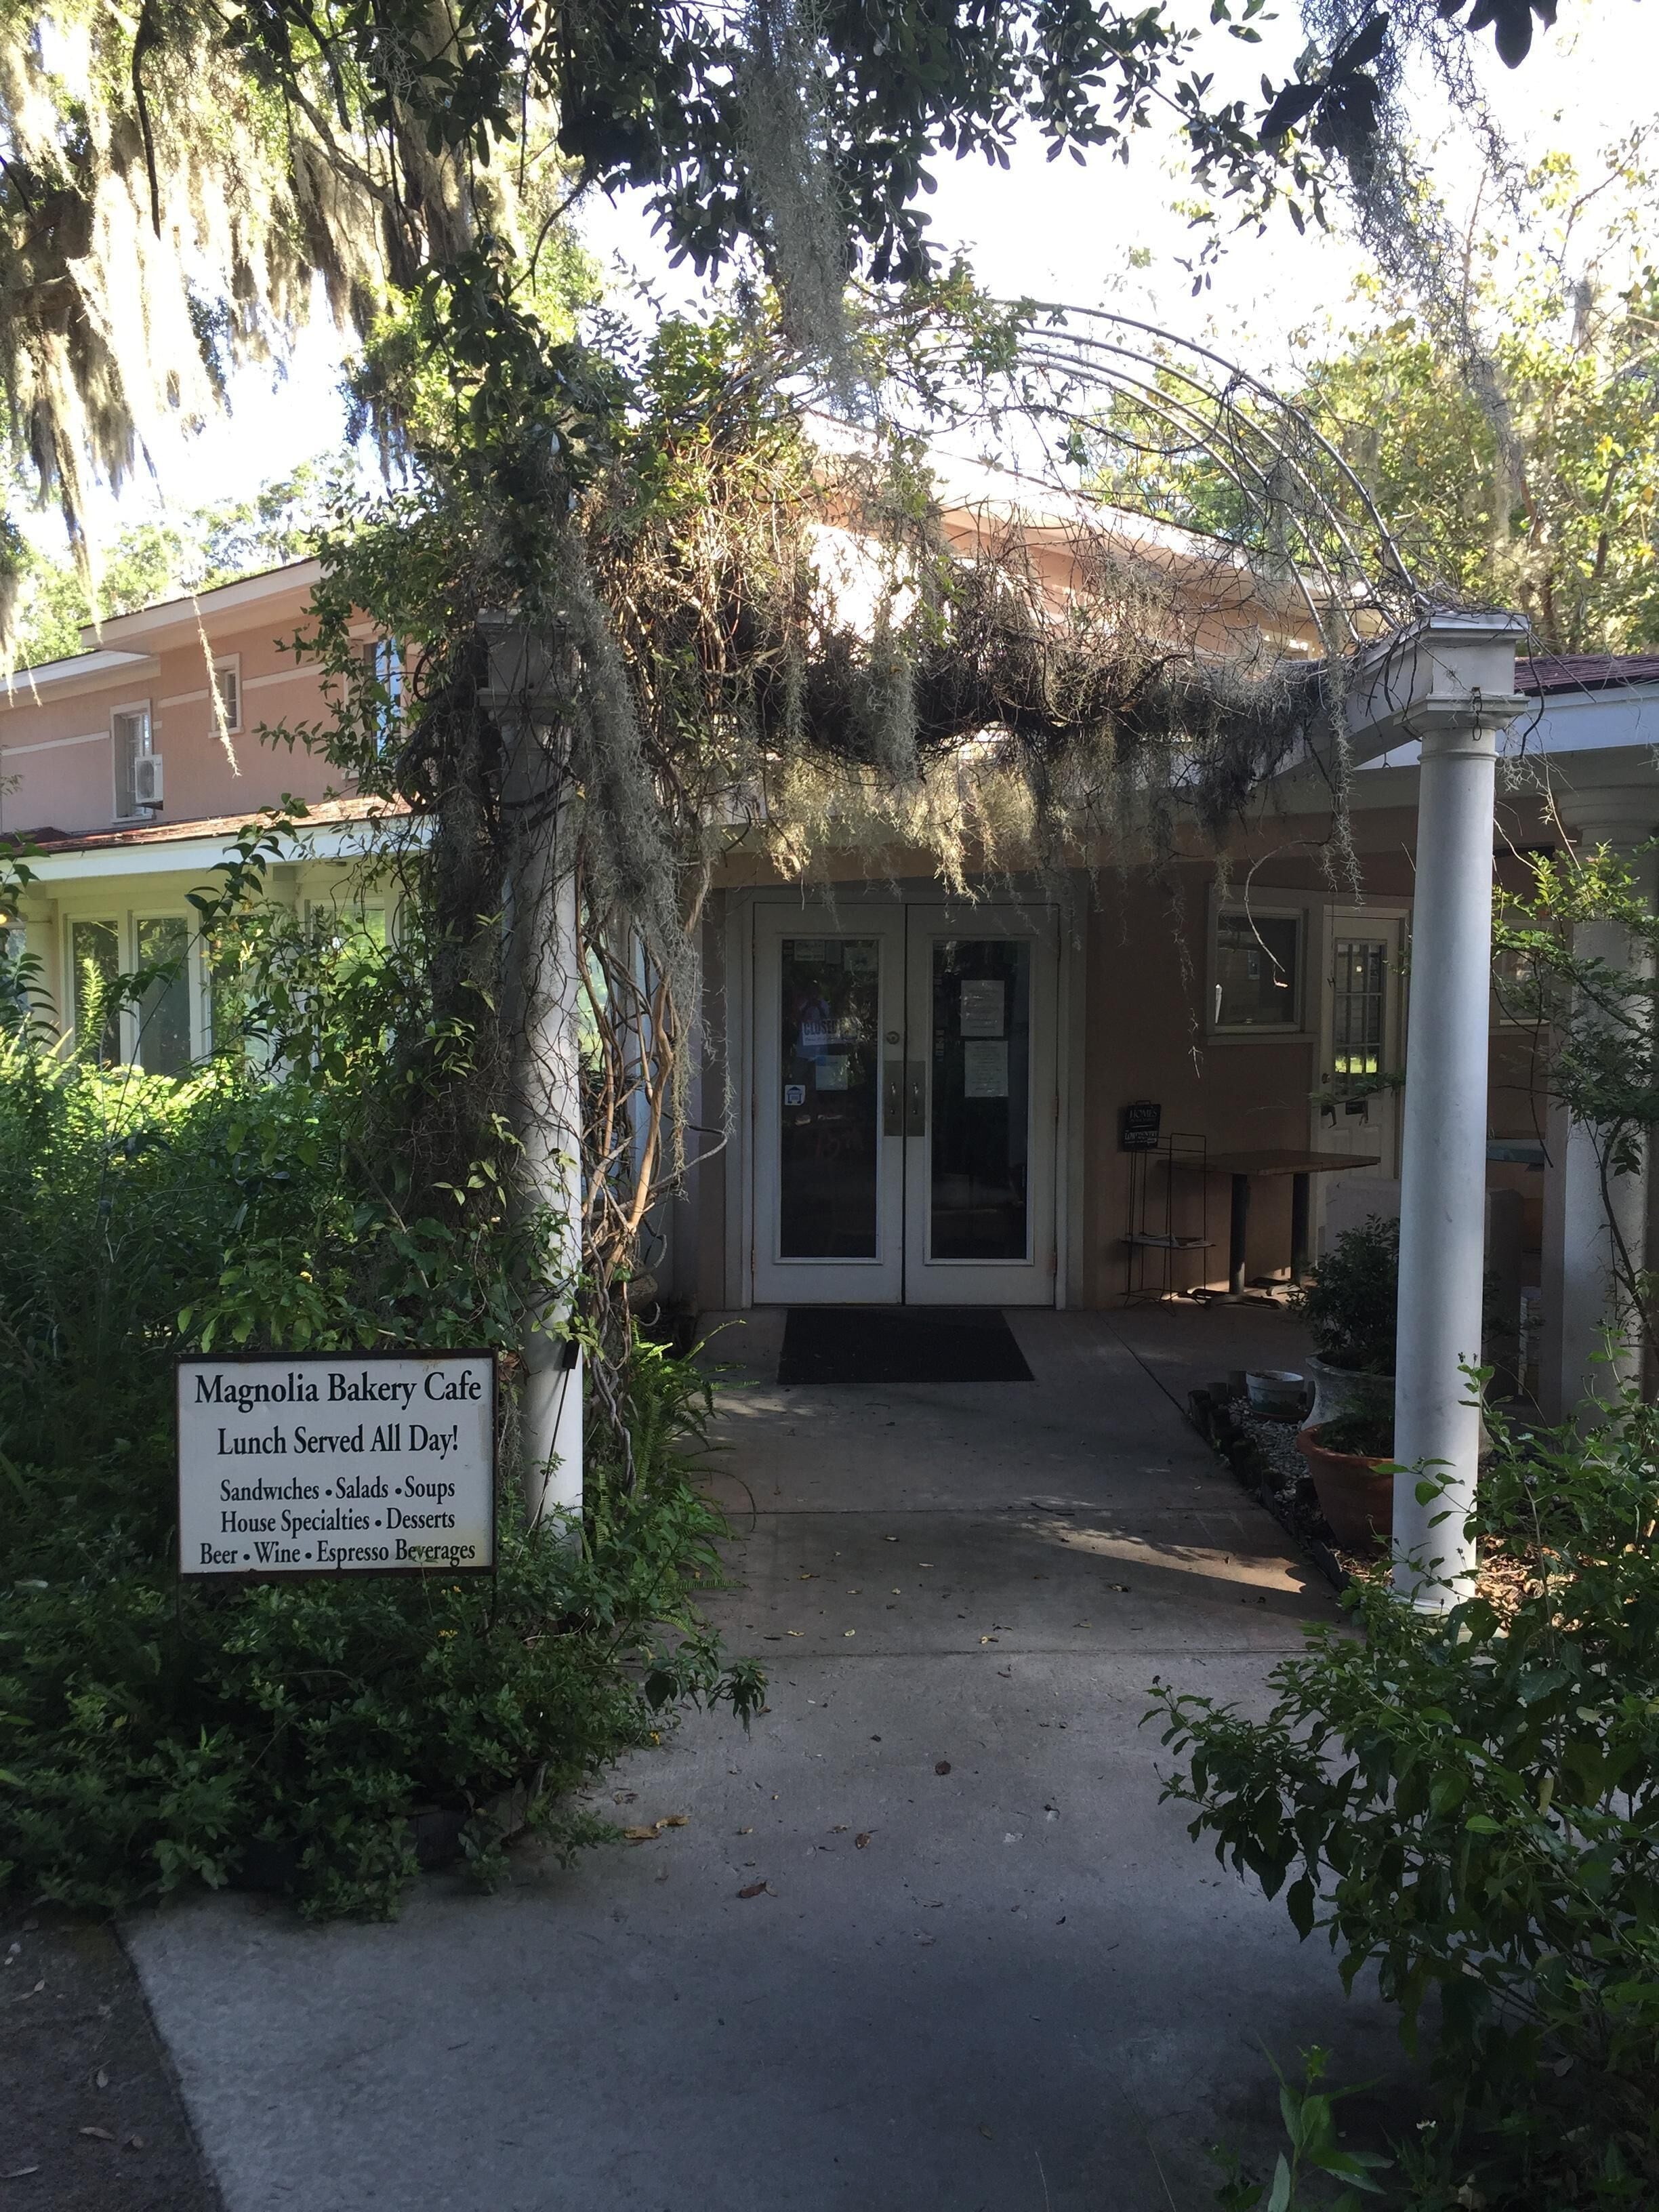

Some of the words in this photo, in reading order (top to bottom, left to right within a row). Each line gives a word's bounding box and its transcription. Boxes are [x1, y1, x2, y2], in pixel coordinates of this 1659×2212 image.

[194, 1372, 320, 1414] Magnolia
[327, 1371, 417, 1411] Bakery
[424, 1370, 482, 1401] Cafe
[217, 1425, 287, 1455] Lunch
[293, 1424, 365, 1454] Served
[369, 1423, 402, 1452] All
[408, 1424, 459, 1460] Day!
[220, 1477, 319, 1502] Sandwiches
[335, 1475, 389, 1499] Salads
[404, 1475, 455, 1504] Soups
[221, 1511, 276, 1533] House
[281, 1508, 370, 1539] Specialties
[386, 1507, 455, 1530] Desserts
[200, 1542, 239, 1565] Beer
[253, 1541, 301, 1563] Wine
[316, 1540, 389, 1566] Espresso
[394, 1538, 476, 1568] Beverages
